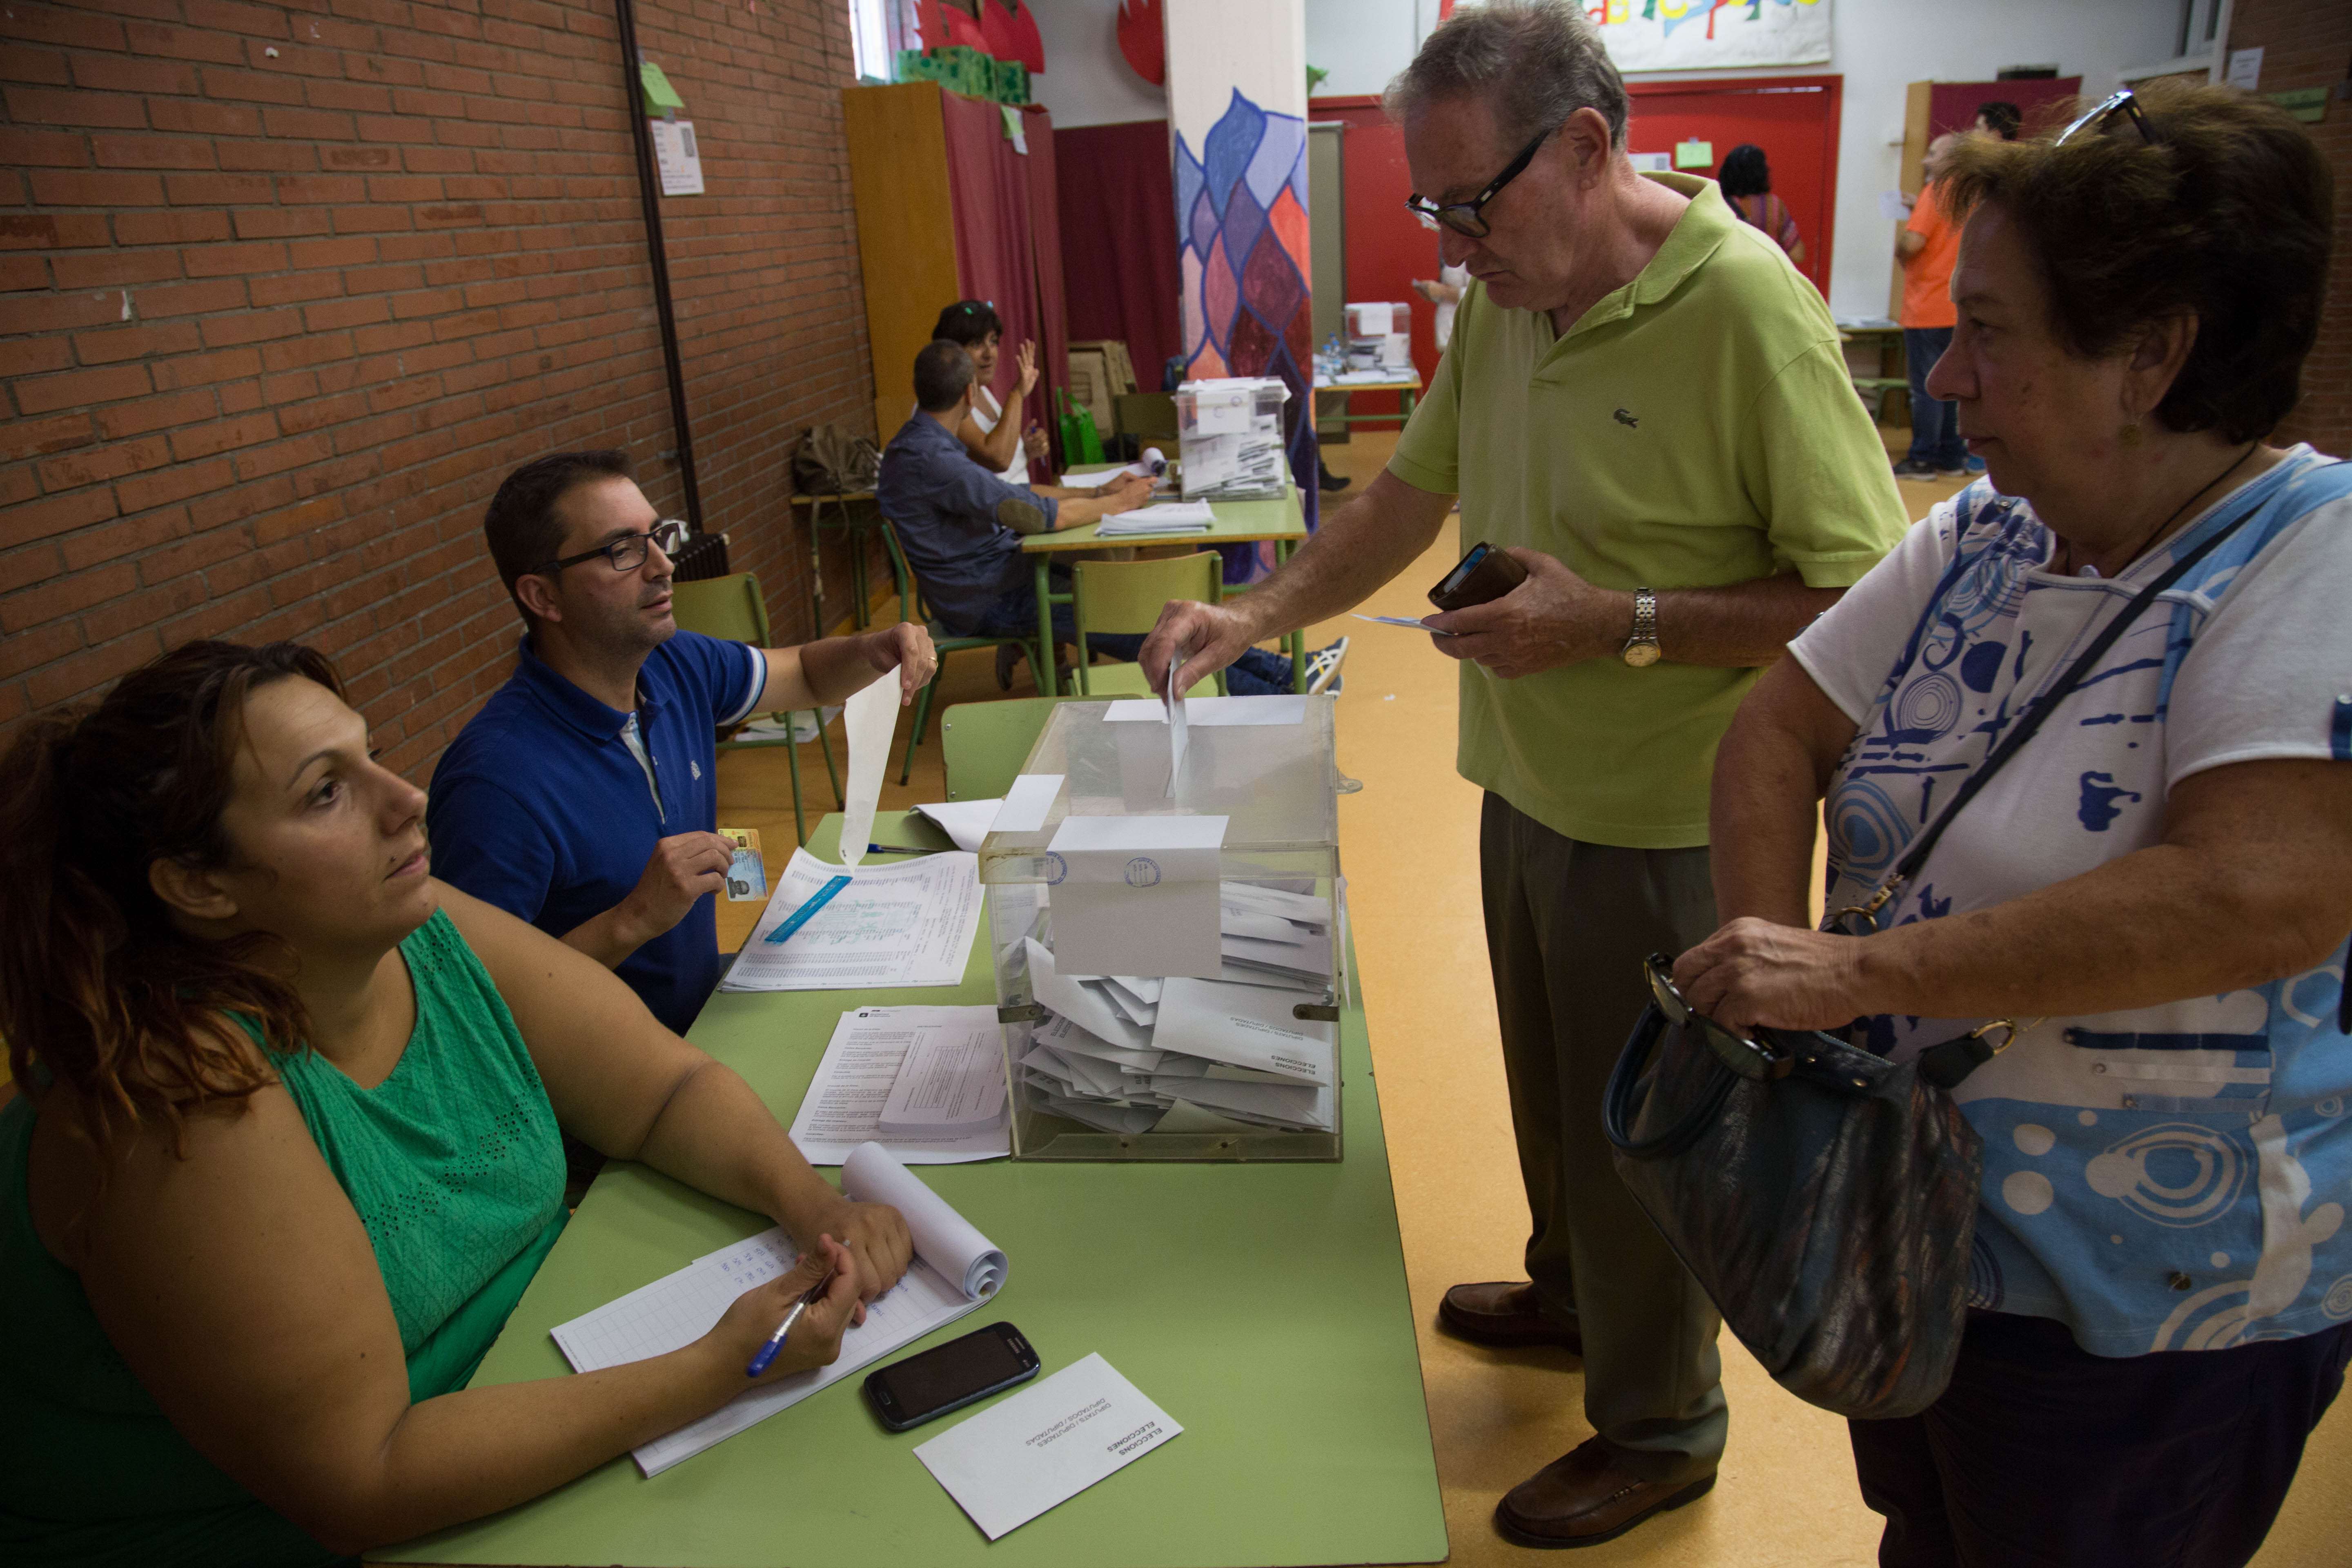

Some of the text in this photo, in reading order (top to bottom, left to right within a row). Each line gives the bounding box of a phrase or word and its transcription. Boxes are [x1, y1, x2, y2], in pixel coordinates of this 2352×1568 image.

[1271, 1055, 1316, 1069] ELECCIONES
[1275, 1062, 1316, 1075] ELECCIONS
[1068, 1398, 1106, 1421] DIPUTADOS
[1079, 1403, 1111, 1423] DIPUTATS
[1026, 1421, 1064, 1446] DIPUTADAS
[1037, 1423, 1076, 1448] DIPUTADES
[1107, 1421, 1155, 1452] ELECCIONES
[1119, 1428, 1163, 1456] ELECCIONS
